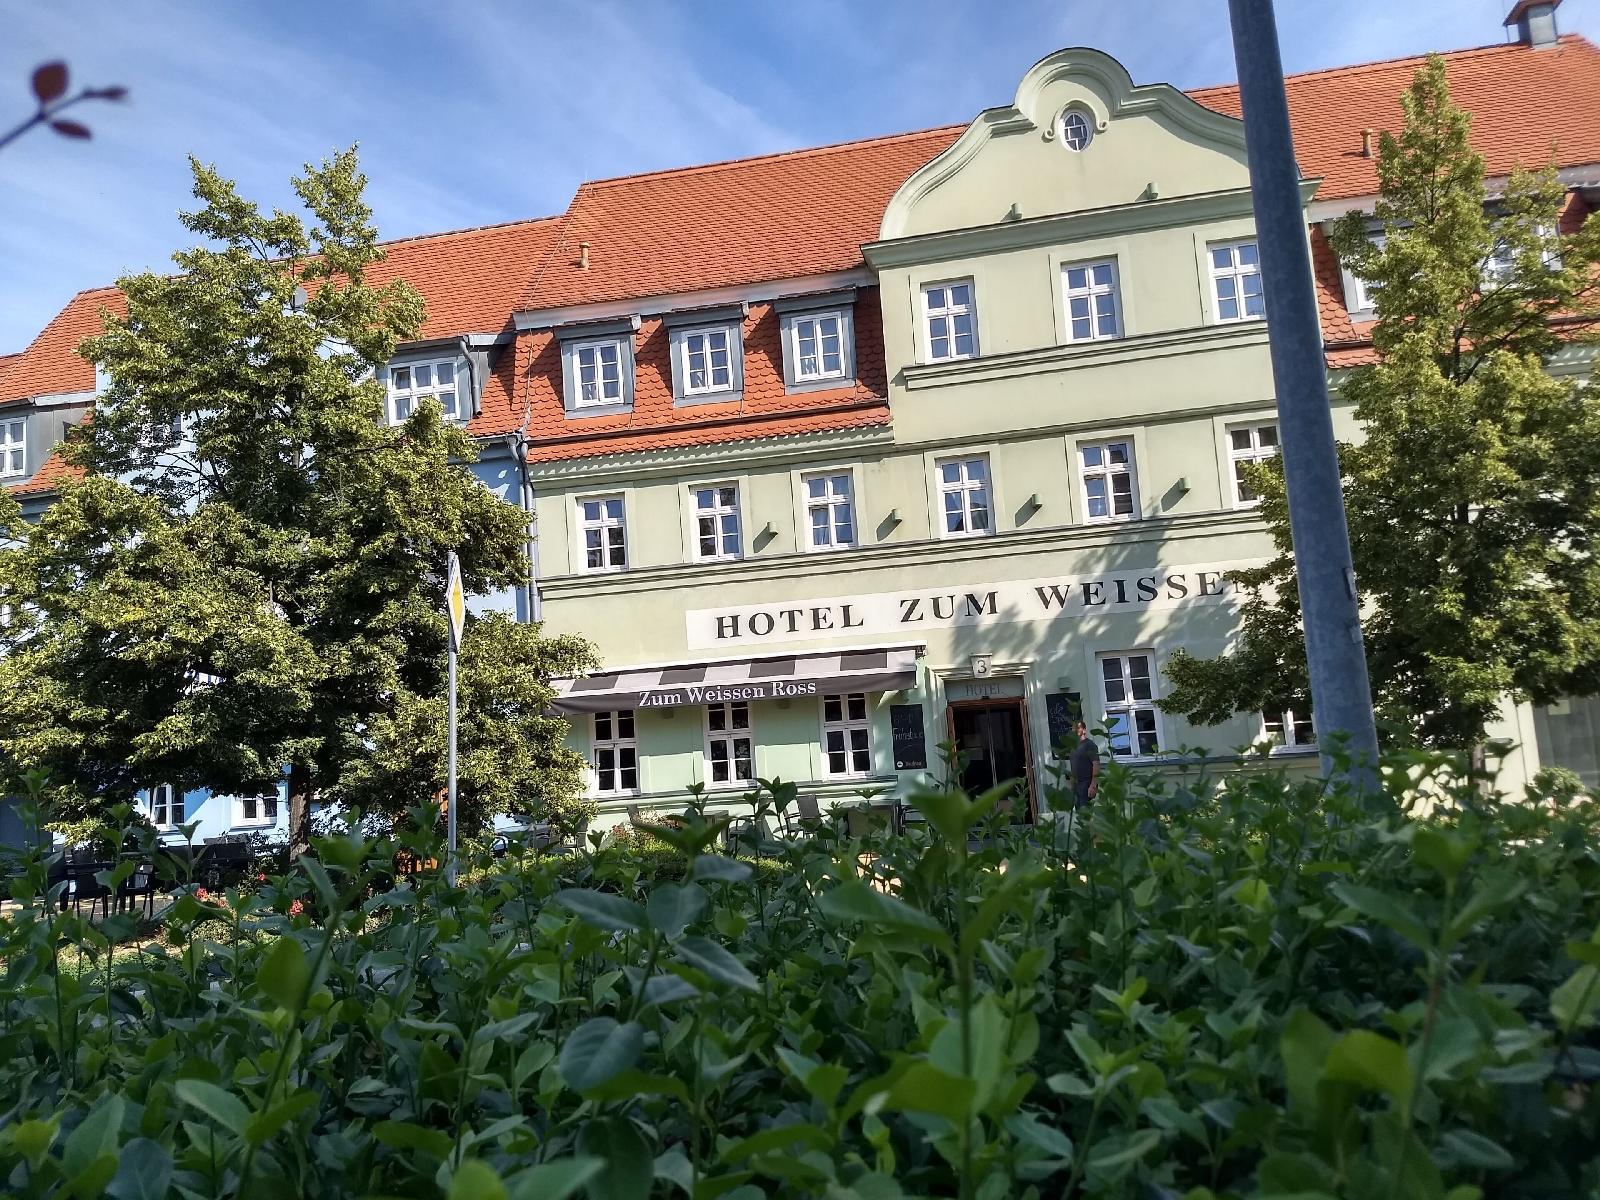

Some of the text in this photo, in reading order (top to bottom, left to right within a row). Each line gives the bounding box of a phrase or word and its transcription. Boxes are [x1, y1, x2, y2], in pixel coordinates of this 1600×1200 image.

[715, 604, 865, 640] HOTEL
[899, 591, 999, 624] ZUM
[977, 659, 987, 674] 3
[639, 681, 817, 707] Zum Weissen Ross
[965, 683, 1003, 697] HOTEL
